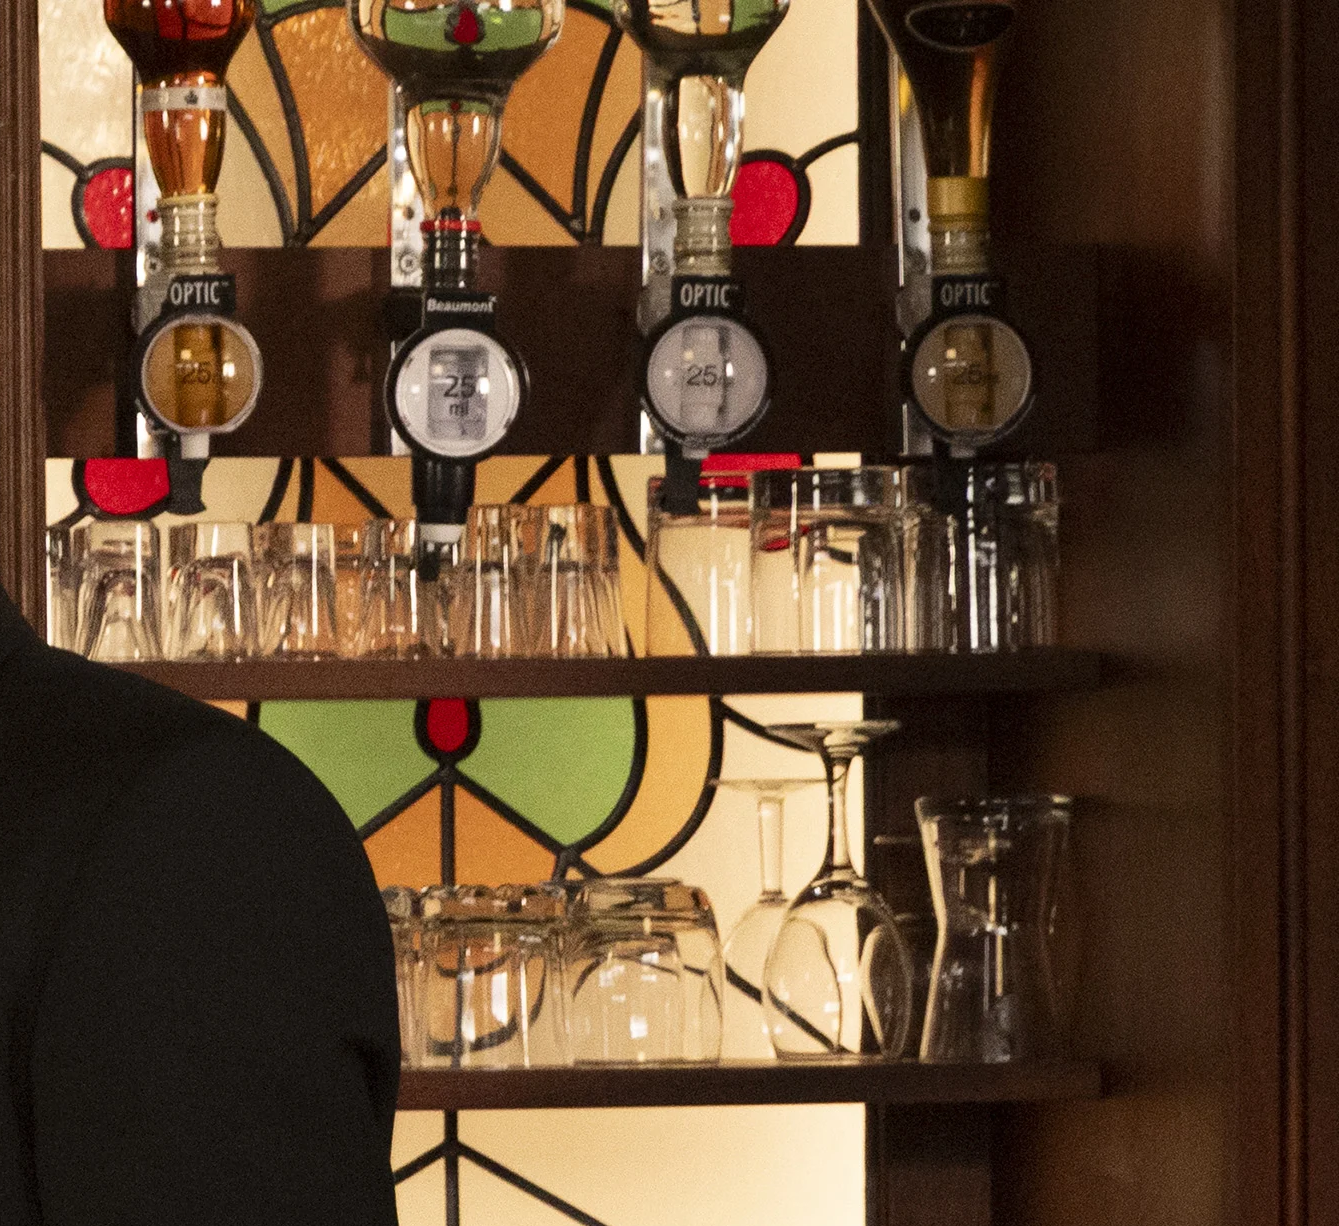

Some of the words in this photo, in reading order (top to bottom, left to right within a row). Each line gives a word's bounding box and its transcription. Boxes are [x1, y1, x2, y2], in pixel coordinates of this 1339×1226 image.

[170, 281, 221, 305] OPTIC
[680, 283, 731, 307] OPTIC
[940, 283, 991, 307] OPTIC
[427, 298, 493, 313] Beaumont
[443, 374, 475, 399] 25
[449, 403, 469, 417] ml
